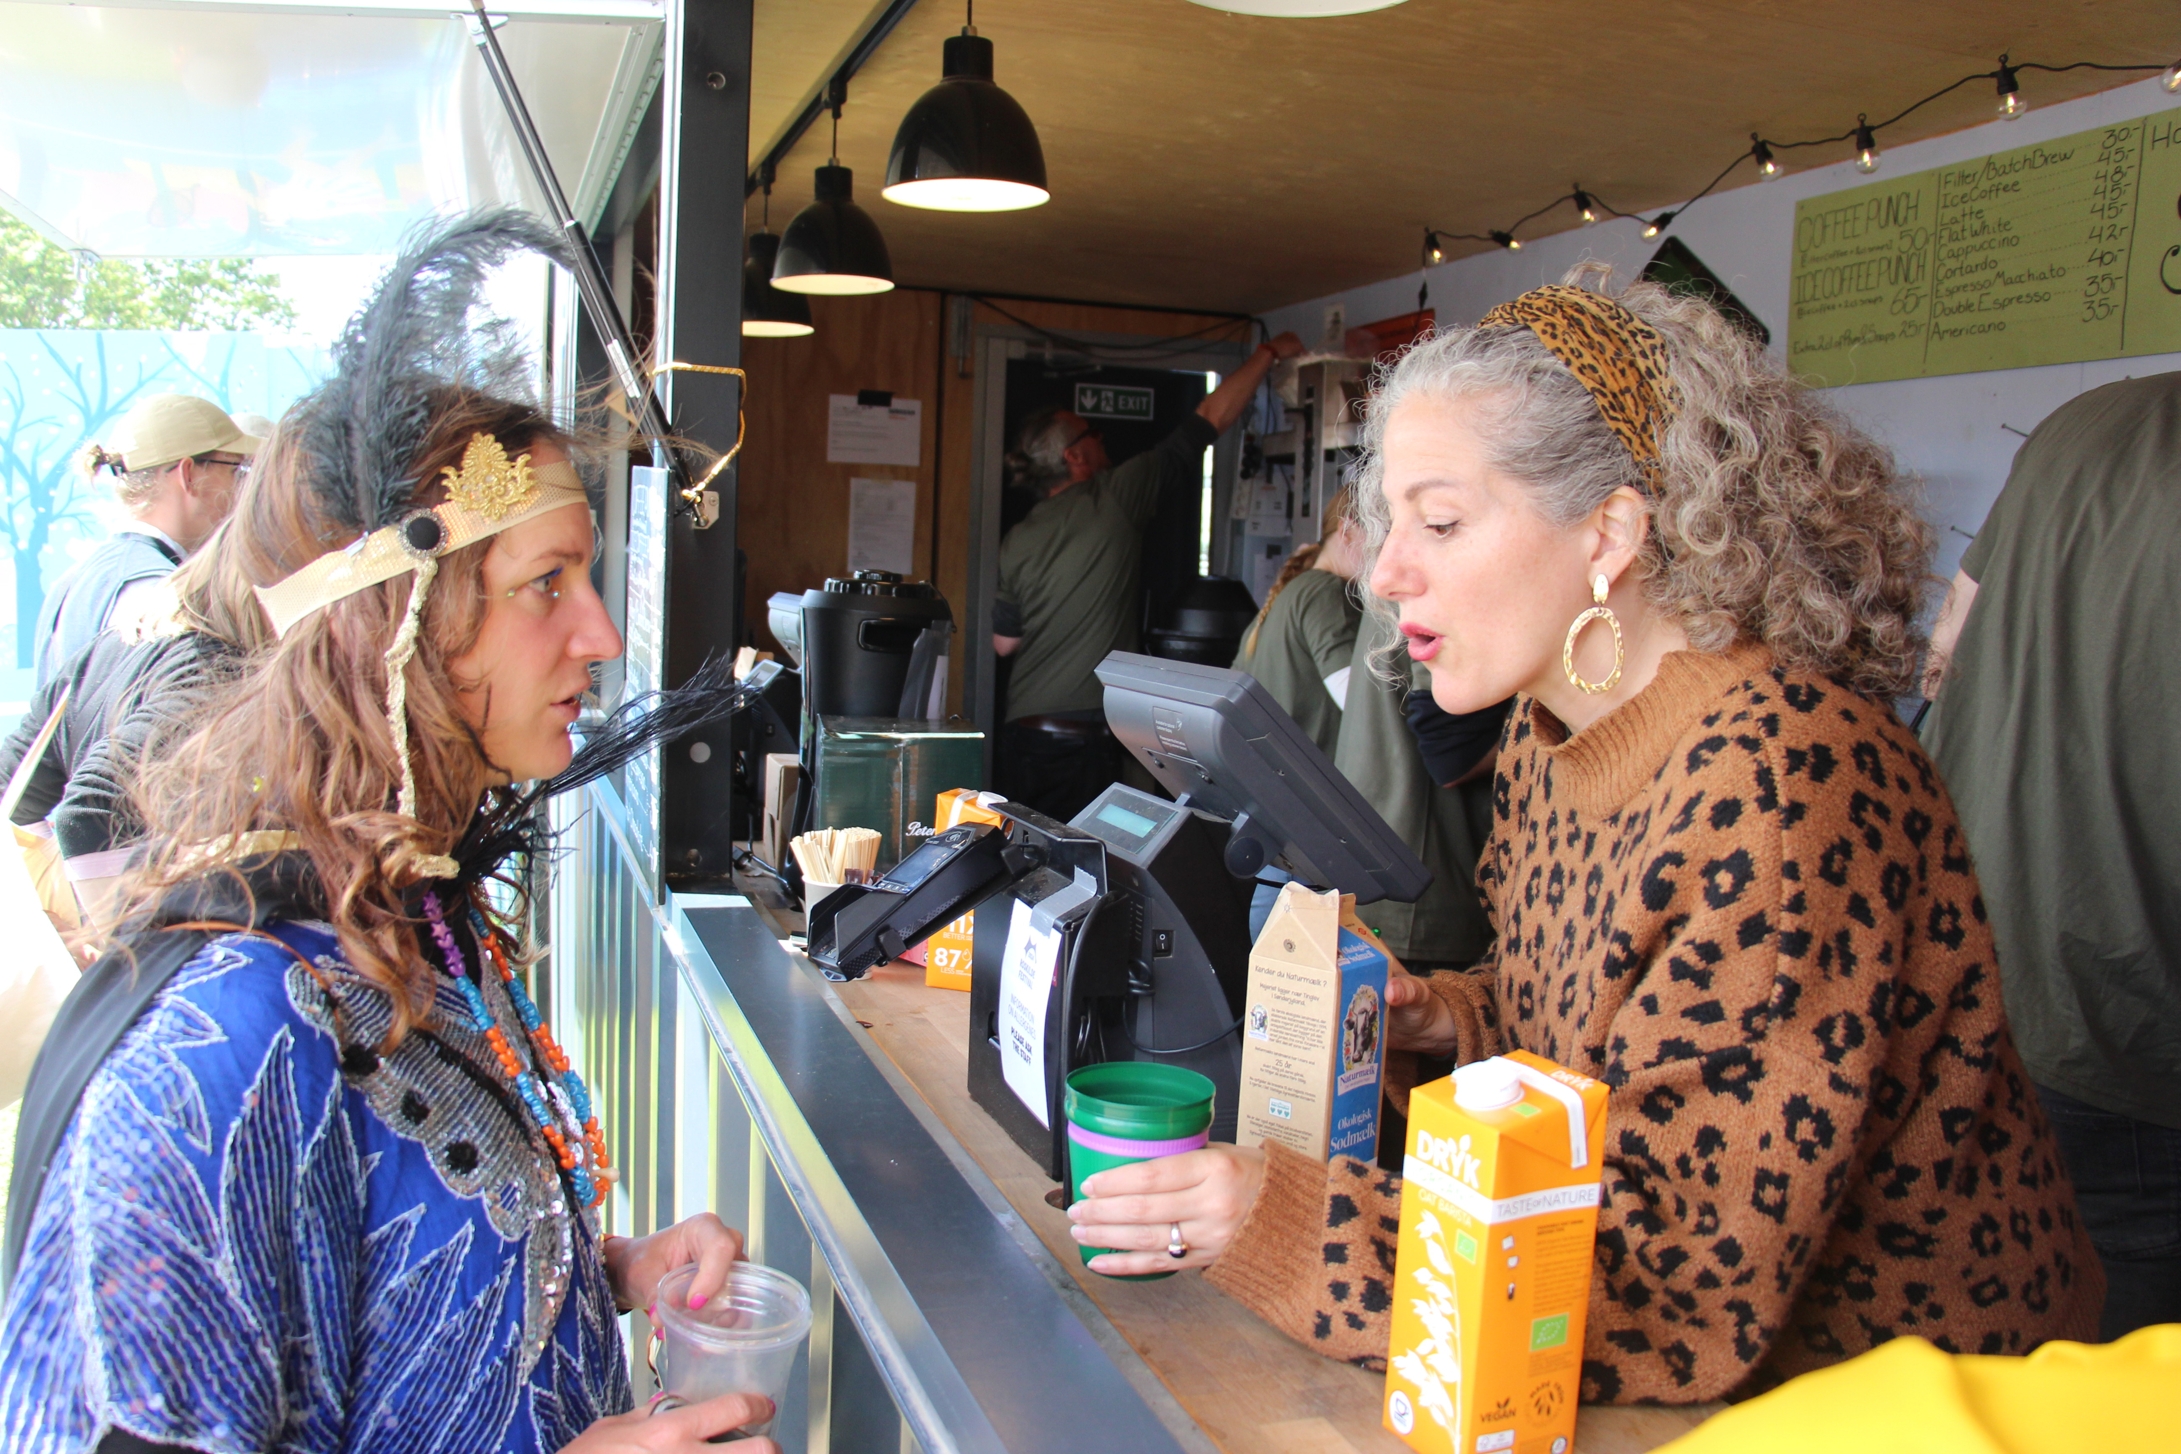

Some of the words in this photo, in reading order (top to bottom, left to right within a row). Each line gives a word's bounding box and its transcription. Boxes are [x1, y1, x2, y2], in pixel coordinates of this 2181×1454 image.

[1940, 205, 1984, 226] Latte
[1937, 235, 2020, 262] Cappuccino
[1931, 321, 2006, 341] Americano
[1119, 395, 1149, 411] EXIT
[942, 931, 966, 940] BETTER
[1010, 1026, 1025, 1047] PLEASE
[1275, 1058, 1283, 1067] 25
[1416, 1129, 1481, 1189] DRYK
[1418, 1188, 1438, 1205] OAT
[1438, 1198, 1472, 1228] BARISTA
[1497, 1197, 1533, 1218] TASTE
[1542, 1187, 1596, 1208] NATURE
[1480, 1409, 1517, 1423] VEGAN
